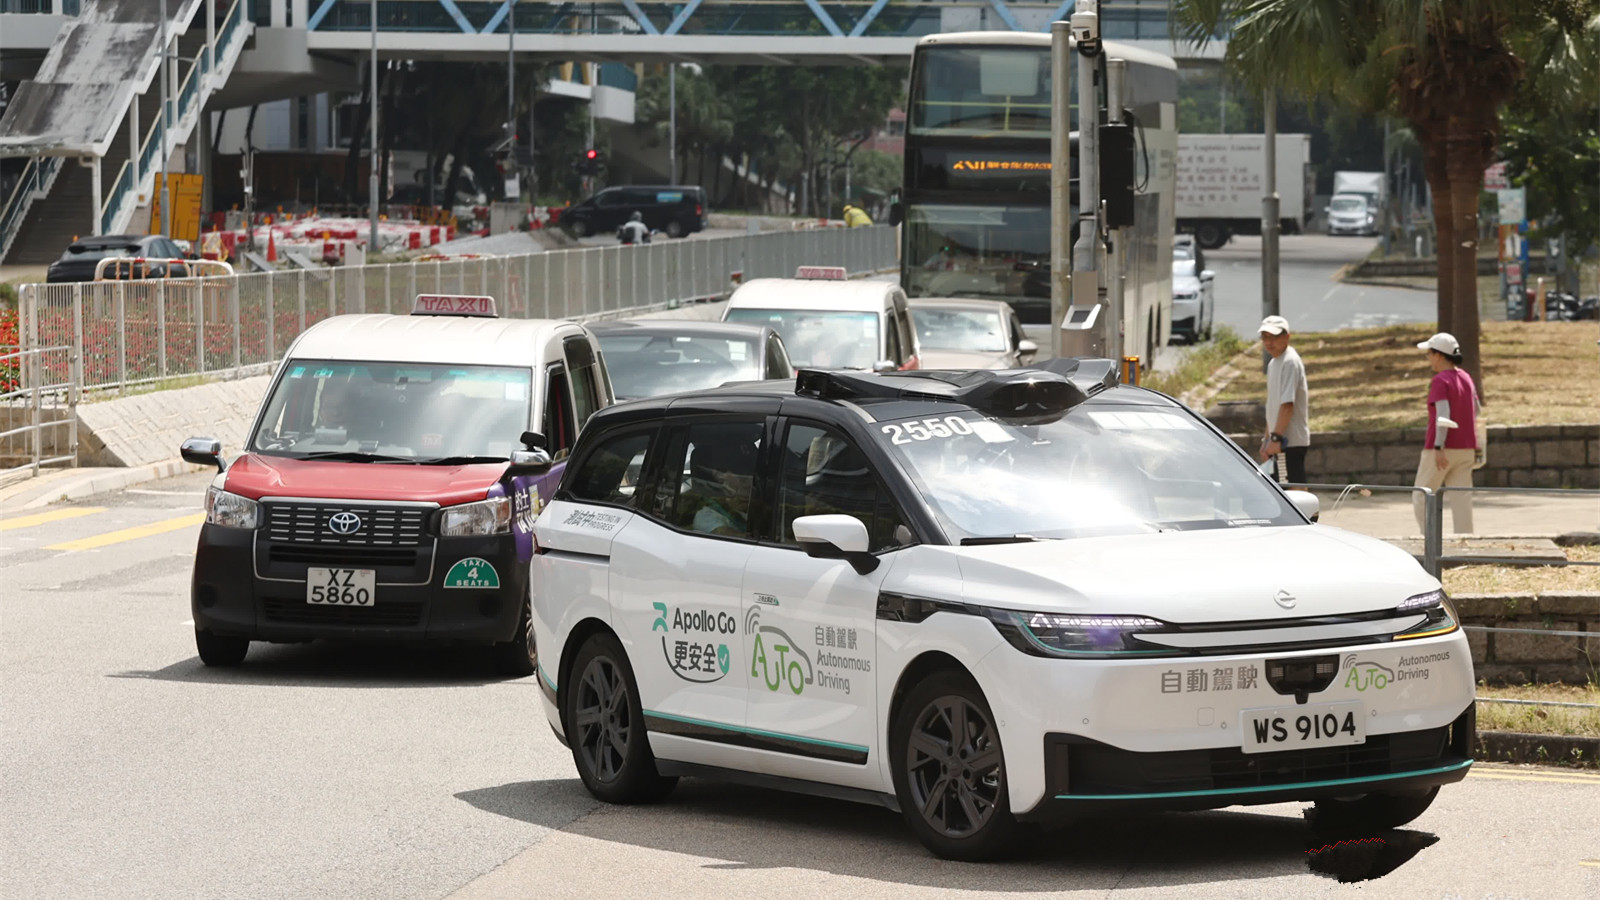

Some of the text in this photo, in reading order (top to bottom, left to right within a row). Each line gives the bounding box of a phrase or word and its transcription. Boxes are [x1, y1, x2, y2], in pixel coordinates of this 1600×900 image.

[421, 296, 488, 313] TAXI
[881, 416, 974, 446] 2550
[462, 560, 485, 568] TAXI
[467, 567, 478, 579] 4
[327, 569, 355, 587] XZ
[311, 585, 369, 605] 5860
[673, 607, 736, 634] Apollo Go
[815, 625, 858, 650] 自動駕駛
[674, 640, 716, 673] 更安全
[817, 649, 871, 672] Autonomous
[1398, 651, 1450, 668] Autonomous
[817, 670, 850, 695] Driving
[1161, 664, 1259, 693] 自動駕駛
[1397, 668, 1430, 681] Driving
[1253, 711, 1356, 743] WS 9104
